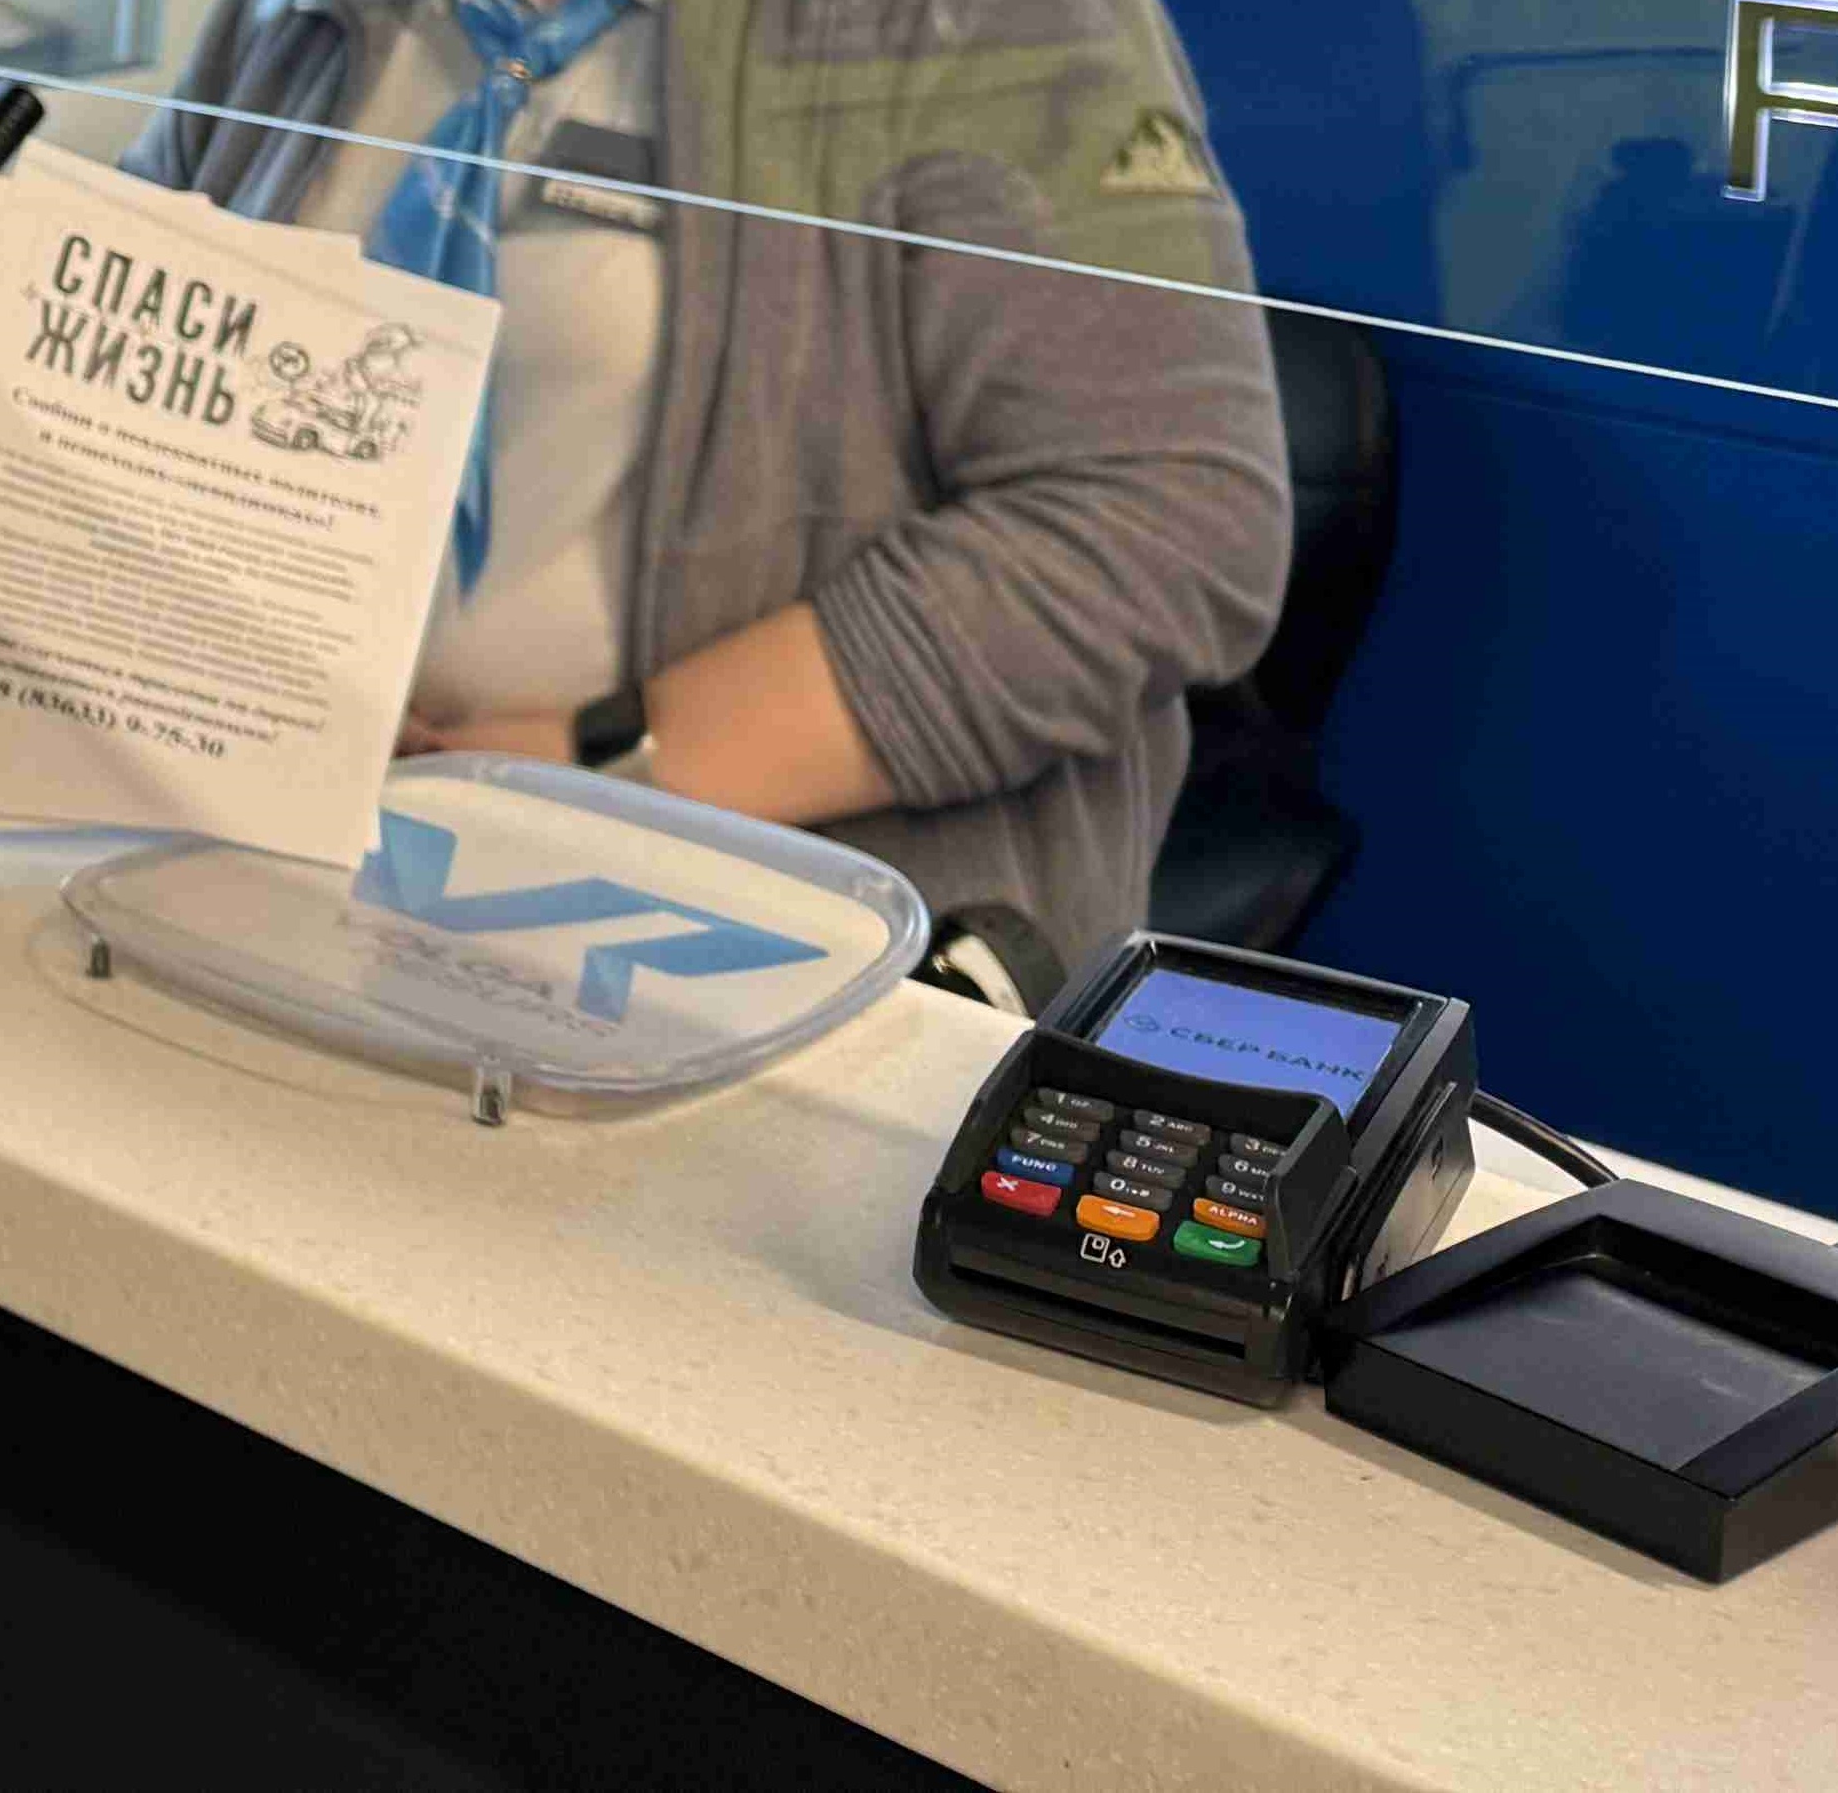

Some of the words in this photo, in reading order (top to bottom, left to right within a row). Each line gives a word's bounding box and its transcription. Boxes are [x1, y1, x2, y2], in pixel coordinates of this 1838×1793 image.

[52, 234, 259, 355] СПАСИ
[25, 299, 237, 426] ЖИЗНЬ
[1149, 1114, 1166, 1126] 2
[1136, 1135, 1152, 1148] 5
[1244, 1139, 1260, 1152] 3
[1011, 1154, 1058, 1172] FUNC
[1234, 1160, 1249, 1173] 6
[1208, 1205, 1259, 1226] ALPHA
